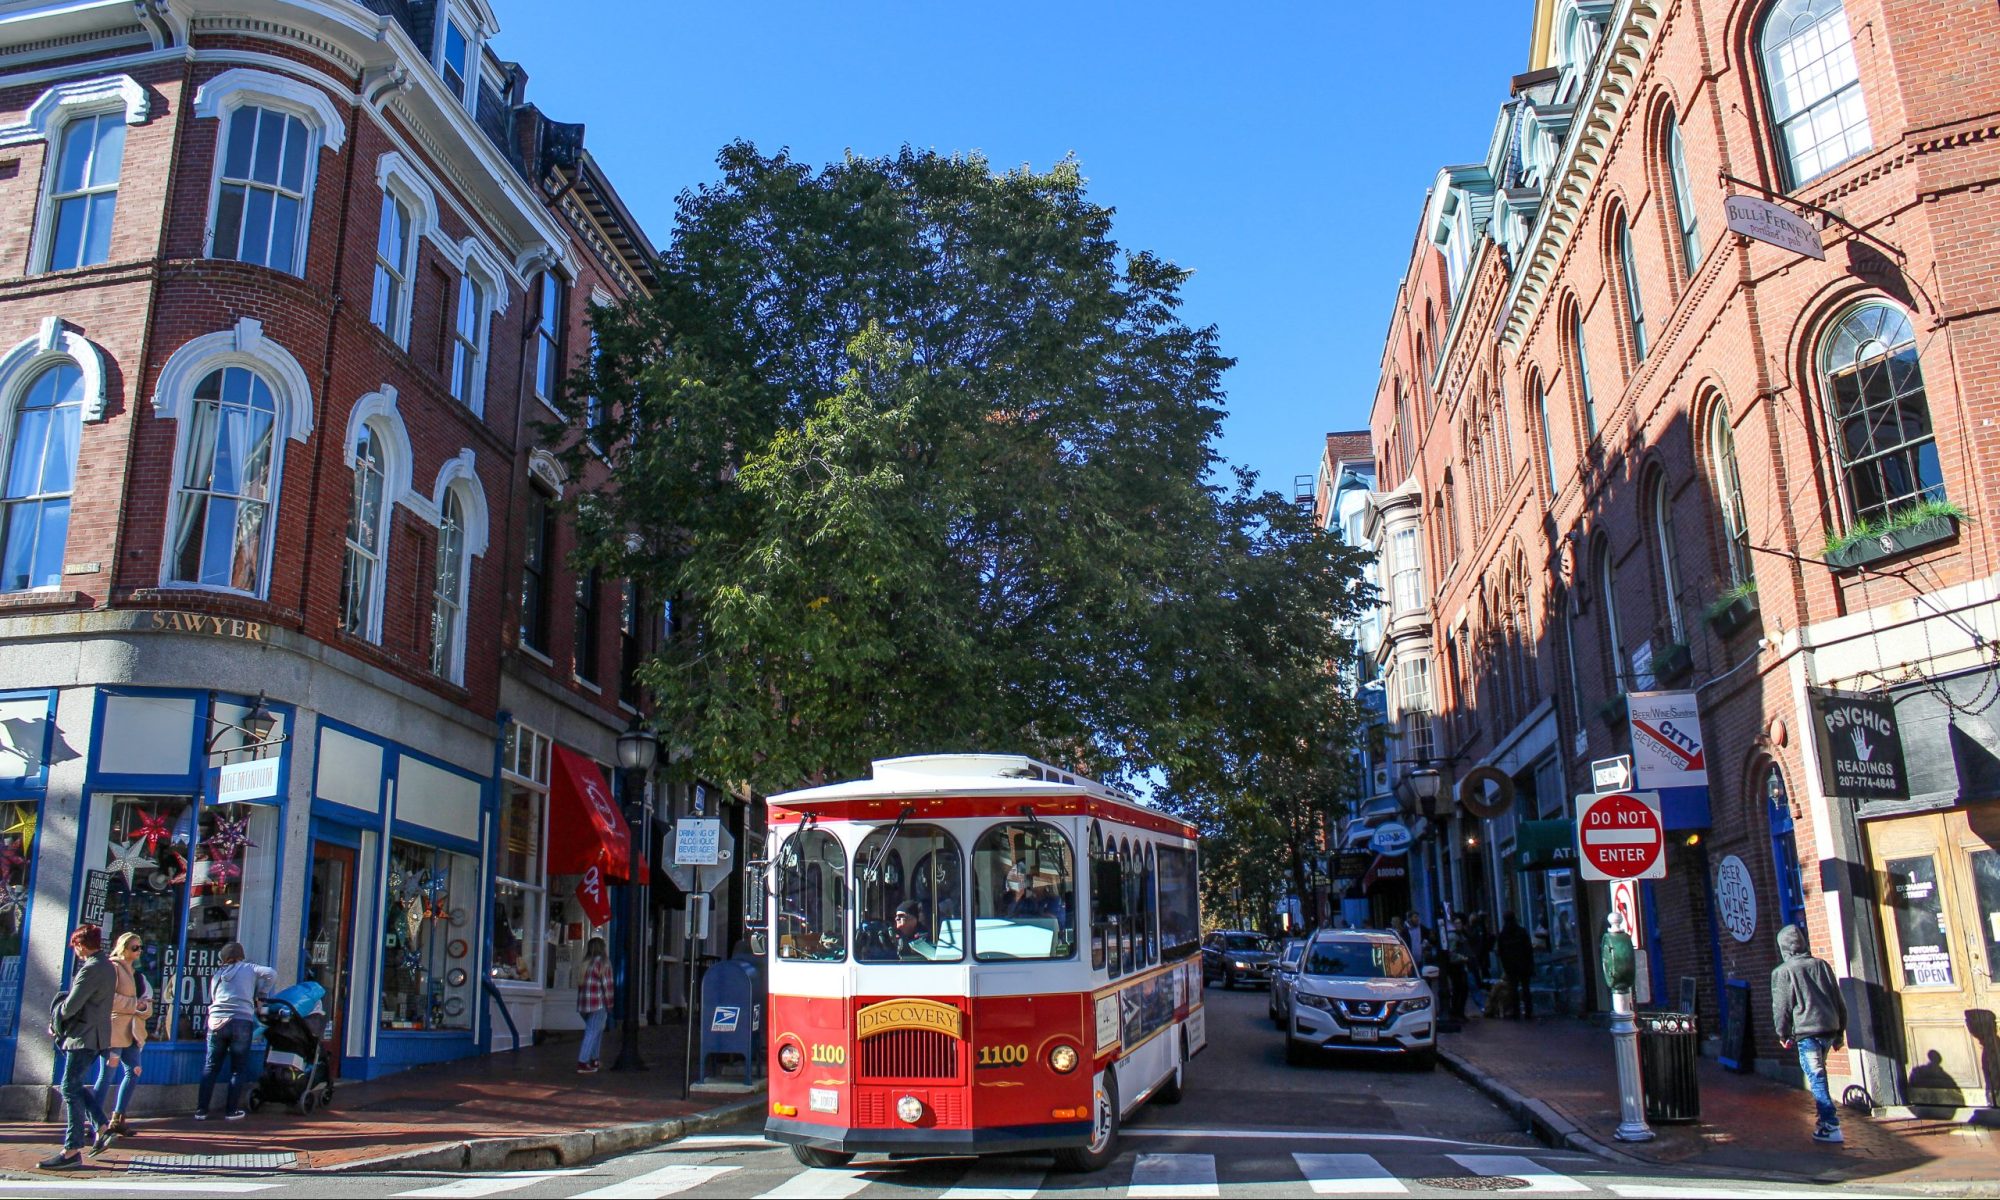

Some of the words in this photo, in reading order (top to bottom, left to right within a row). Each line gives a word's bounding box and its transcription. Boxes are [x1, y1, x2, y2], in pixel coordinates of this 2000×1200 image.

[1765, 209, 1819, 250] FEENEY'S
[151, 611, 262, 641] SAWYER
[1824, 706, 1891, 736] PSYCHIC
[1659, 720, 1700, 753] CITY
[1633, 729, 1688, 771] BEVERAGE
[1837, 760, 1894, 776] READINGS
[211, 766, 274, 796] PNDEMONIUM
[1839, 776, 1896, 790] 207-774-4848
[1591, 811, 1611, 825] DO
[1617, 811, 1648, 825] NOT
[678, 829, 707, 837] DRINKNG
[707, 829, 717, 837] OF
[1599, 848, 1646, 862] ENTER
[1721, 864, 1742, 882] BEER
[1908, 870, 1916, 883] 1
[90, 877, 110, 891] HOME
[1720, 880, 1748, 901] LOTTO
[85, 903, 104, 921] LIFE
[1723, 897, 1751, 921] WINE
[1917, 968, 1947, 983] OPEN
[862, 1007, 956, 1029] DISCOVERY
[811, 1043, 845, 1064] 1100
[979, 1044, 1029, 1064] 1100
